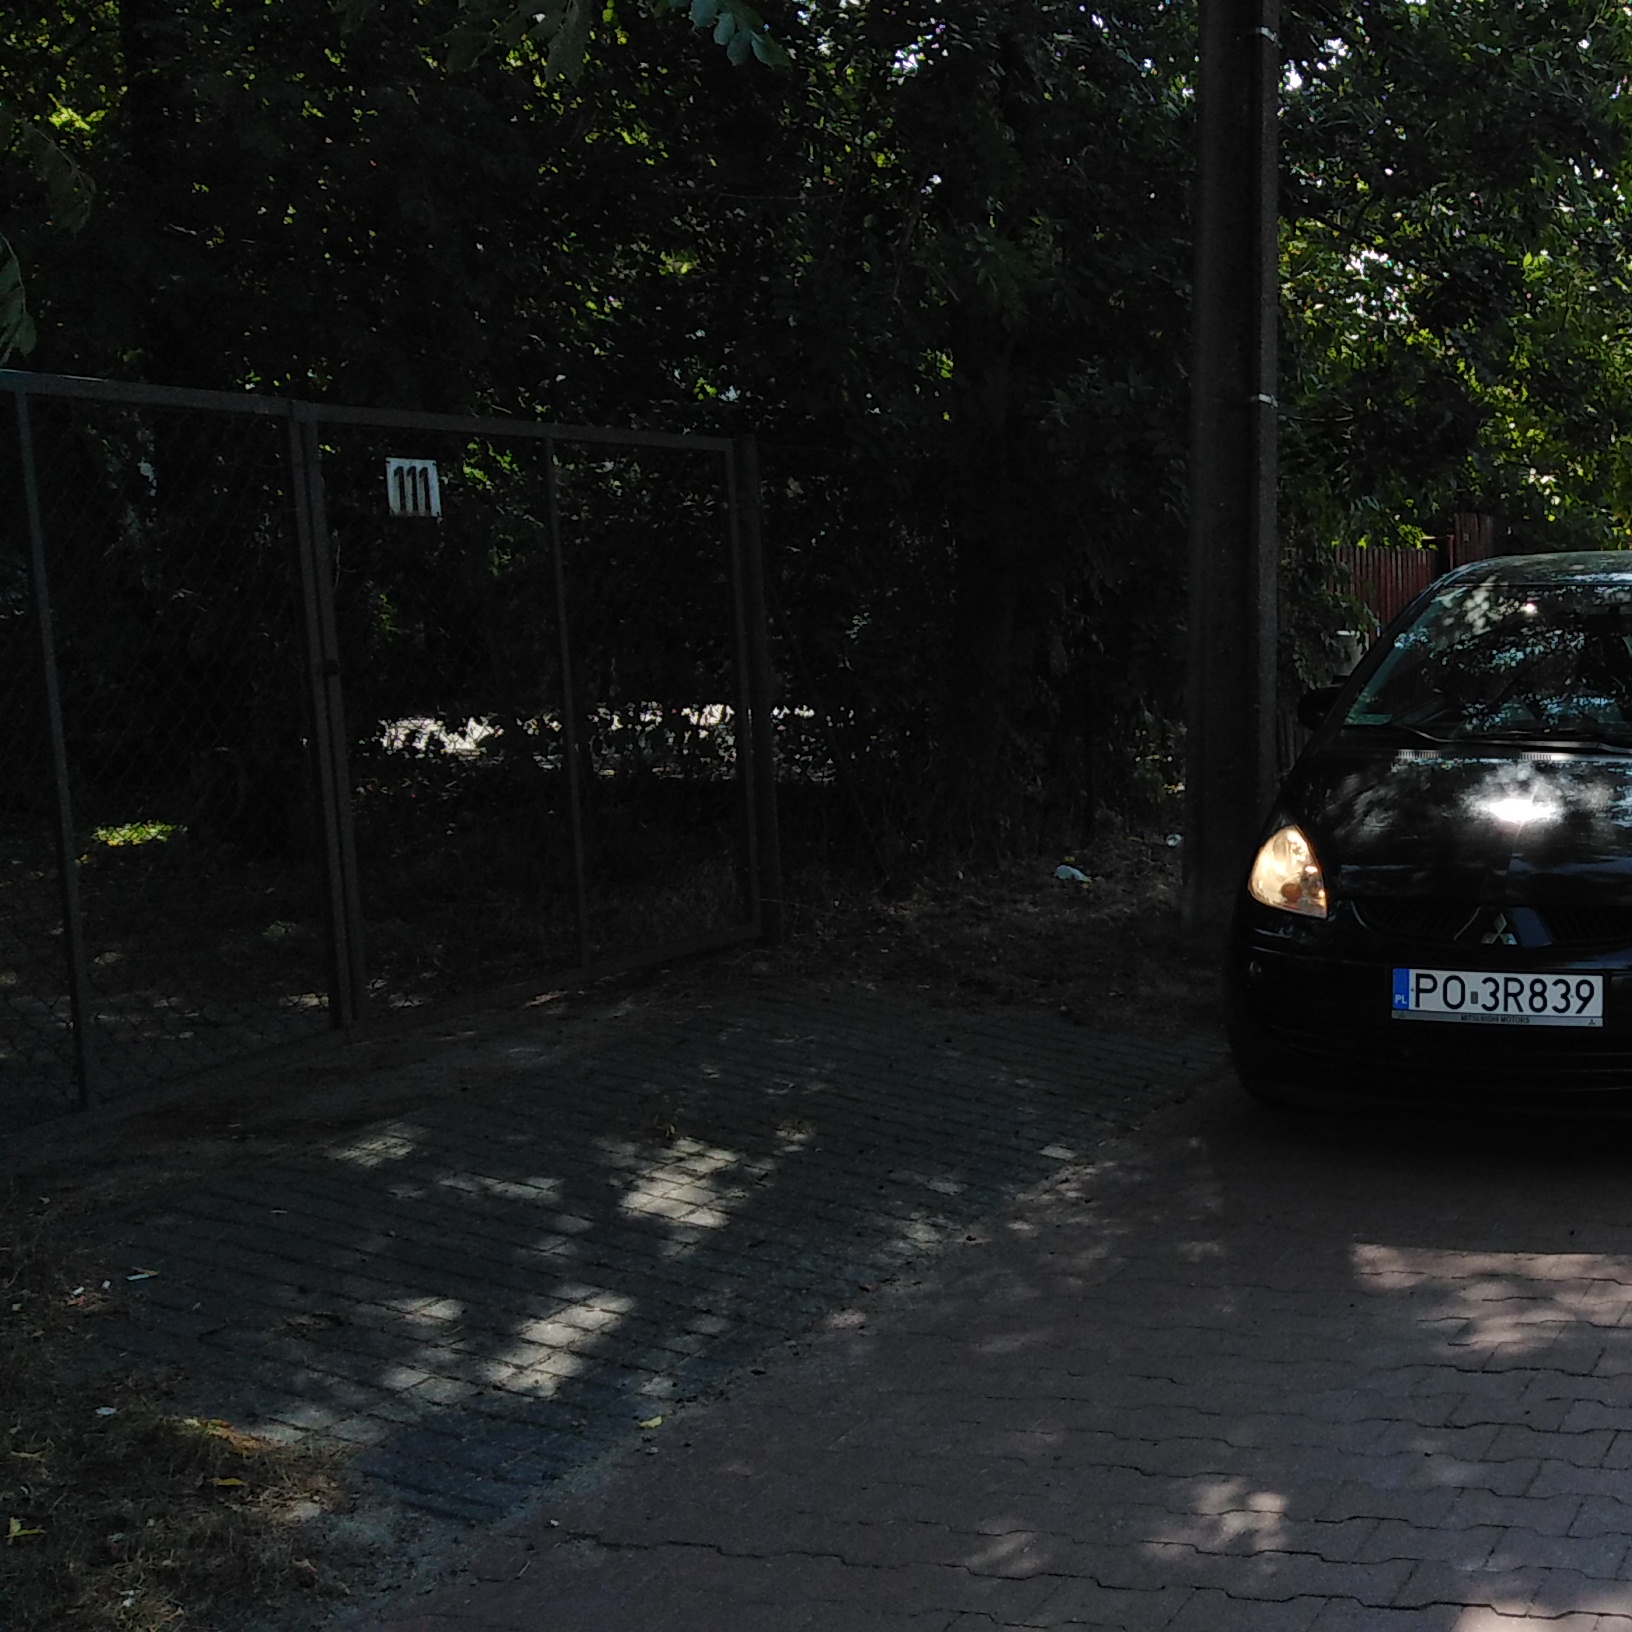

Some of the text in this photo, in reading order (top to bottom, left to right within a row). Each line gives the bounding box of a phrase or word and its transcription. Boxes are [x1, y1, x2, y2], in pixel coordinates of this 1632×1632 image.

[393, 466, 431, 511] 111
[1394, 993, 1408, 1005] PL
[1414, 972, 1595, 1014] PO 3R839
[1500, 1016, 1531, 1025] MOTORS
